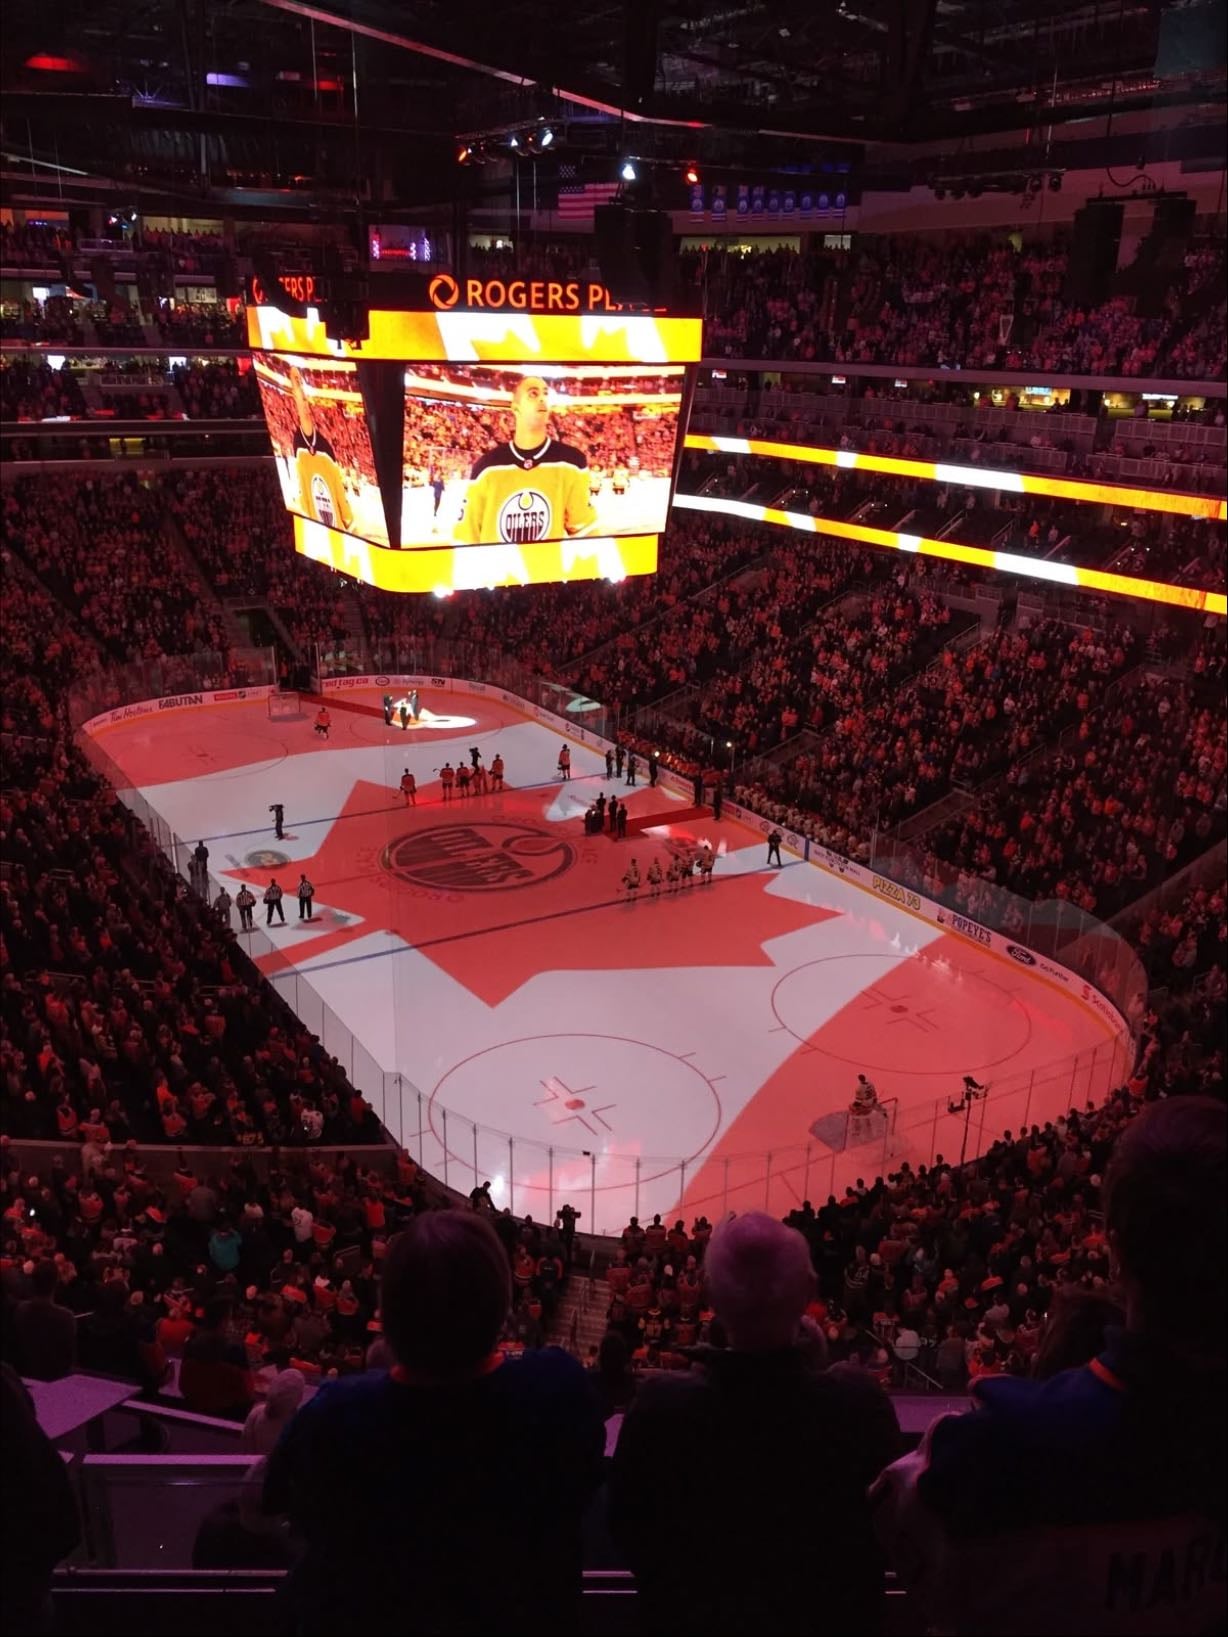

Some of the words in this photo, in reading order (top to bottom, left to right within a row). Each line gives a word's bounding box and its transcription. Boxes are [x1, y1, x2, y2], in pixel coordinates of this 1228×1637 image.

[466, 279, 580, 310] ROGERS
[505, 511, 545, 542] OILERS
[158, 694, 203, 710] FABUTAN
[872, 874, 906, 904] PIZZA
[906, 890, 921, 911] 73
